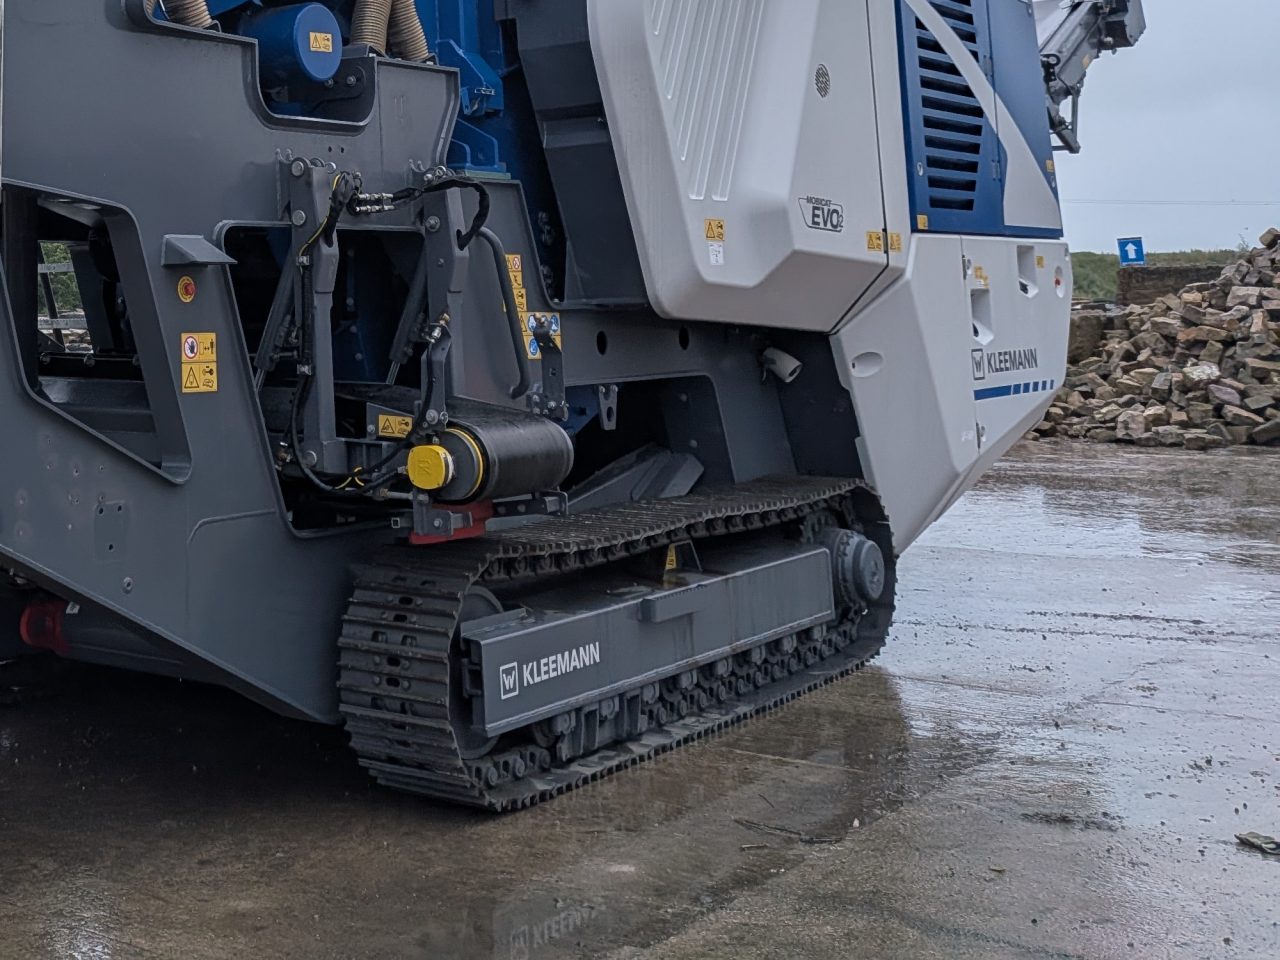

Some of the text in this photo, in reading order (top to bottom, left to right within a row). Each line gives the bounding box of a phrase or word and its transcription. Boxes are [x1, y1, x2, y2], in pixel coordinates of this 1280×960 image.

[806, 195, 832, 208] MOBICAT
[986, 348, 1039, 374] KLEEMANN
[522, 641, 601, 688] KLEEMANN
